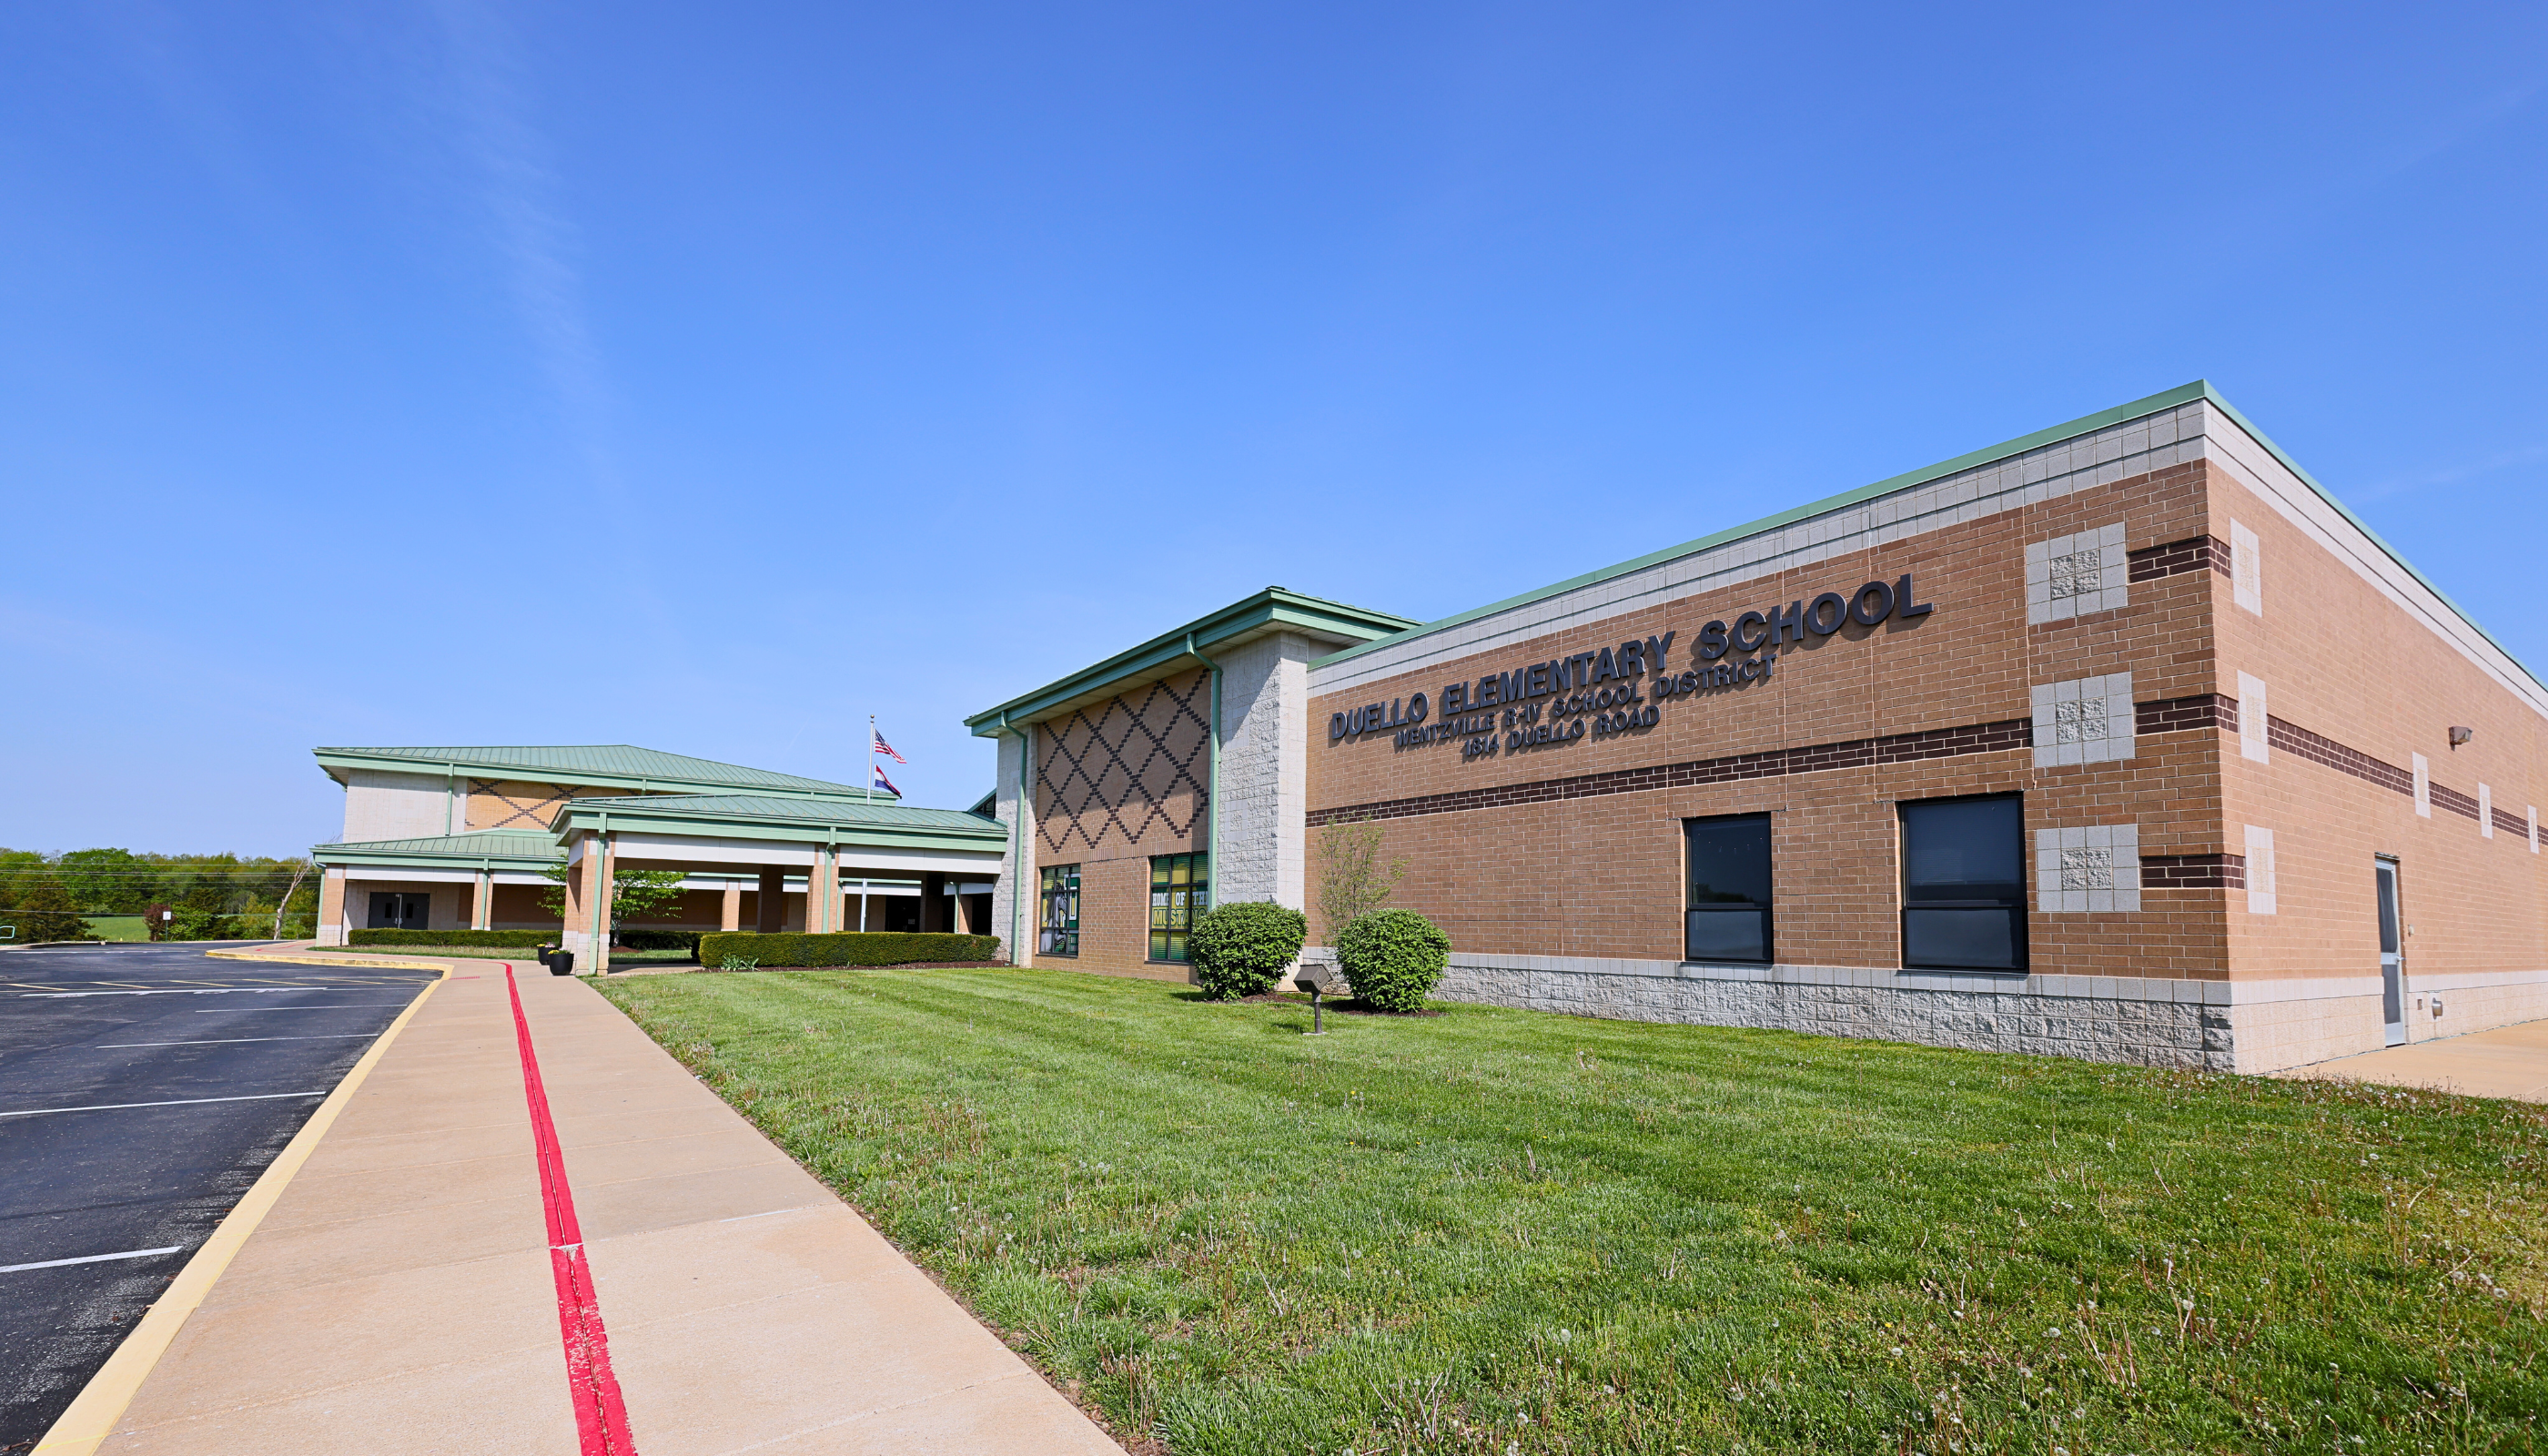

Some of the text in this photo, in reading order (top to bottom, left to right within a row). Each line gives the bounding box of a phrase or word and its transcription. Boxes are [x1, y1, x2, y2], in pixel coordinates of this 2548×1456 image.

[1331, 572, 1935, 739] DUELLO ELEMENTARY SCHOOL
[1397, 653, 1777, 747] WENTZVILLE R-IV SCHOOL DISTRICT
[1465, 705, 1661, 756] 1814 DUELLO ROAD
[1152, 892, 1169, 907] HOME
[1176, 892, 1186, 906] OF
